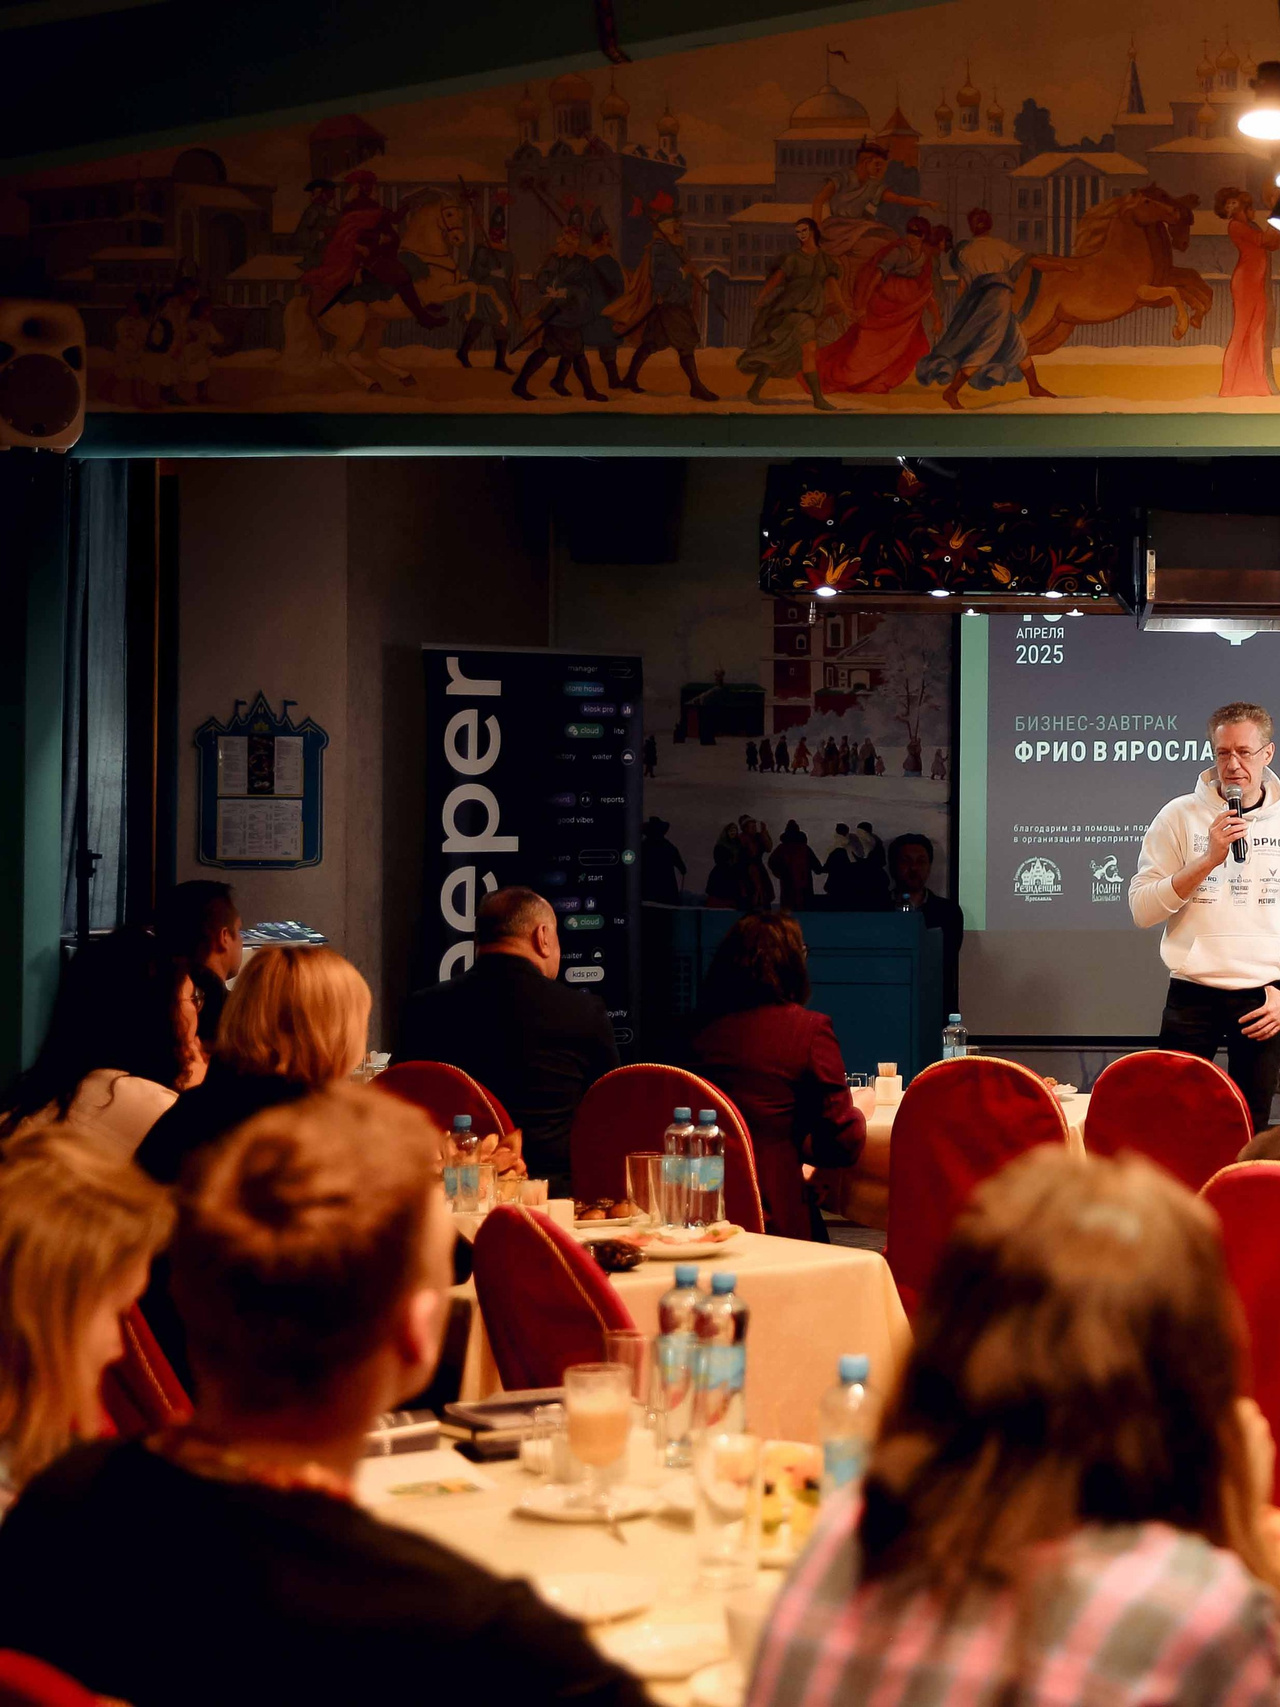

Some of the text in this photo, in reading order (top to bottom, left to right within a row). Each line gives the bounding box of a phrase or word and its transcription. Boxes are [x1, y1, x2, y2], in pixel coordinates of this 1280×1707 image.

[1016, 627, 1065, 639] АПРЕЛЯ
[1015, 644, 1064, 664] 2025
[567, 665, 599, 674] manager
[583, 684, 605, 693] house
[583, 704, 614, 715] kiosk pro
[1015, 714, 1178, 731] БИЗНЕС-ЗАВТРАК
[580, 726, 599, 734] cloud
[613, 727, 625, 735] lite
[592, 752, 612, 760] waiter
[1014, 740, 1087, 763] ФРИО
[1093, 740, 1108, 762] В
[600, 795, 624, 804] reports
[576, 816, 594, 824] vibes
[1013, 824, 1068, 833] благодарим
[1085, 825, 1121, 834] помощь
[1022, 835, 1081, 844] организации
[558, 854, 571, 863] pro
[587, 873, 603, 882] start
[580, 917, 599, 925] cloud
[613, 917, 625, 925] lite
[572, 970, 598, 979] kds pro
